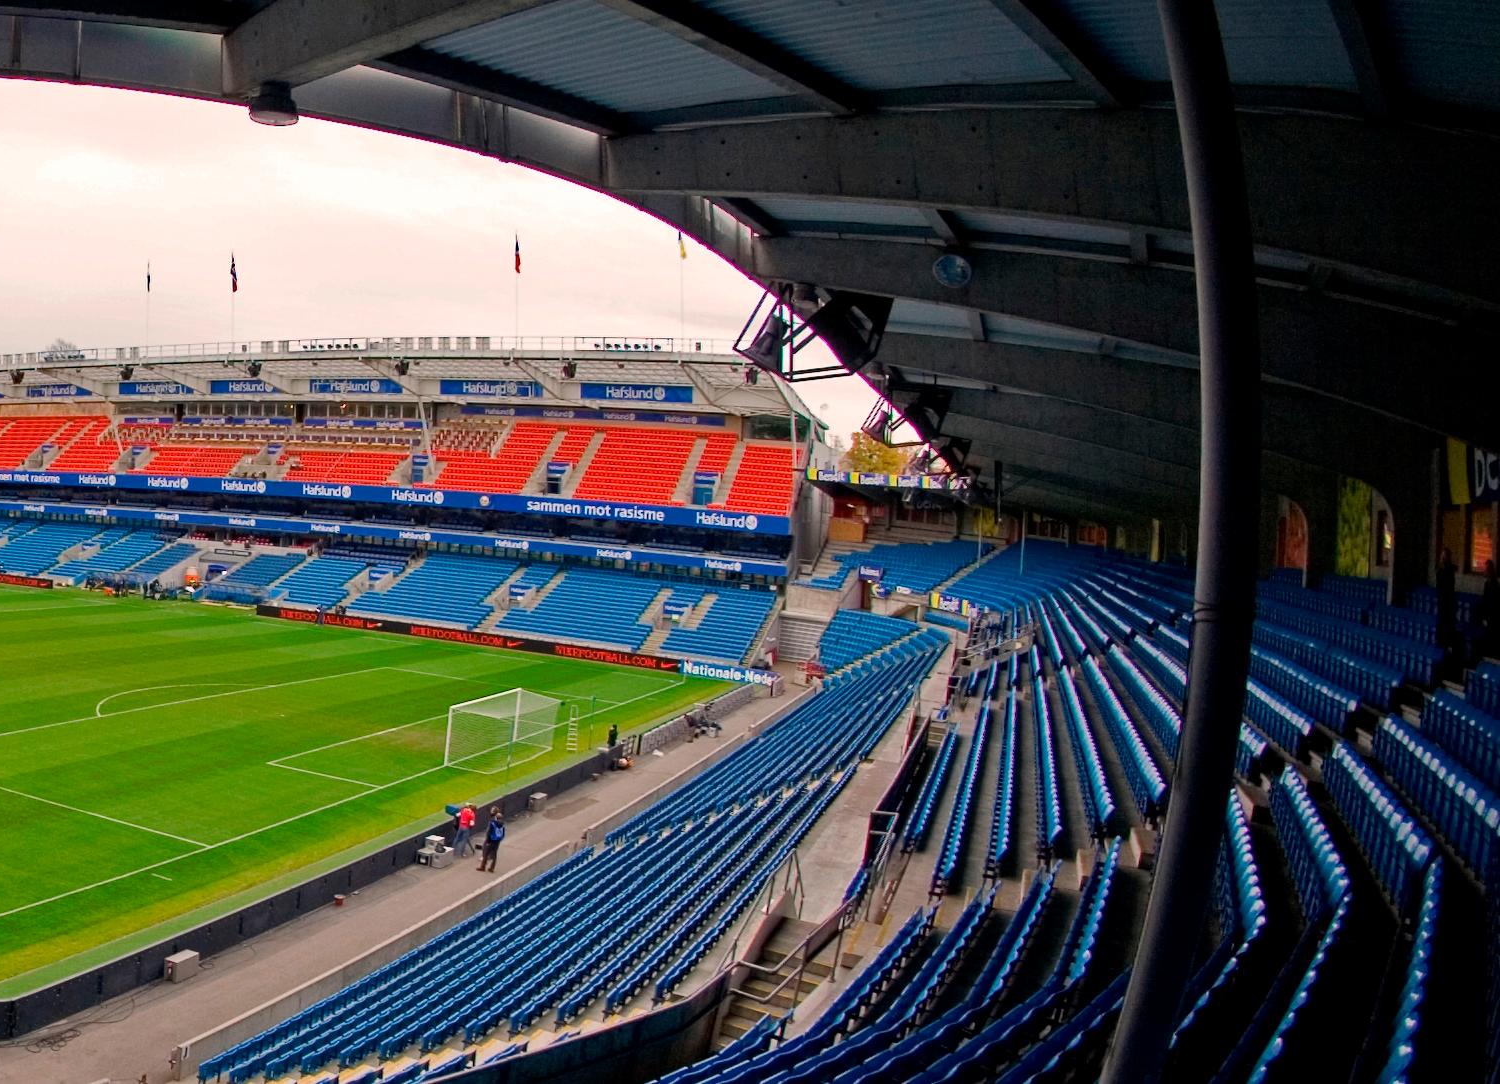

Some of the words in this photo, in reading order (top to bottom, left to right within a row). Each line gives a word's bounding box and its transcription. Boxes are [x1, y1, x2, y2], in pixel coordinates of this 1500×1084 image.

[229, 382, 265, 392] Hafslund
[331, 380, 370, 391] Hafslund
[463, 384, 507, 394] Hafslund
[606, 386, 653, 399] Hafslund
[14, 473, 29, 483] mot
[30, 474, 60, 484] rasisme
[78, 474, 109, 485] Hafslund
[148, 477, 180, 489] Hafslund
[221, 480, 257, 492] Hafslund
[303, 484, 342, 497] Hafslund
[392, 489, 434, 503] Hafslund
[526, 500, 581, 515] sammen
[584, 505, 611, 517] mot
[614, 507, 665, 522] rasisme
[228, 517, 251, 526] Hafslund
[696, 512, 745, 528] Hafslund
[310, 523, 335, 532] Hafslund
[399, 531, 425, 540] Hafslund
[494, 539, 523, 549] Hafslund
[596, 548, 627, 559] Hafslund
[704, 559, 735, 570] Hafslund
[280, 609, 364, 628] NIKEFOOALL.COM
[411, 625, 503, 646] NIKEFOOTBALL.COM
[555, 645, 656, 668] NIKEFOOTBALL.COM
